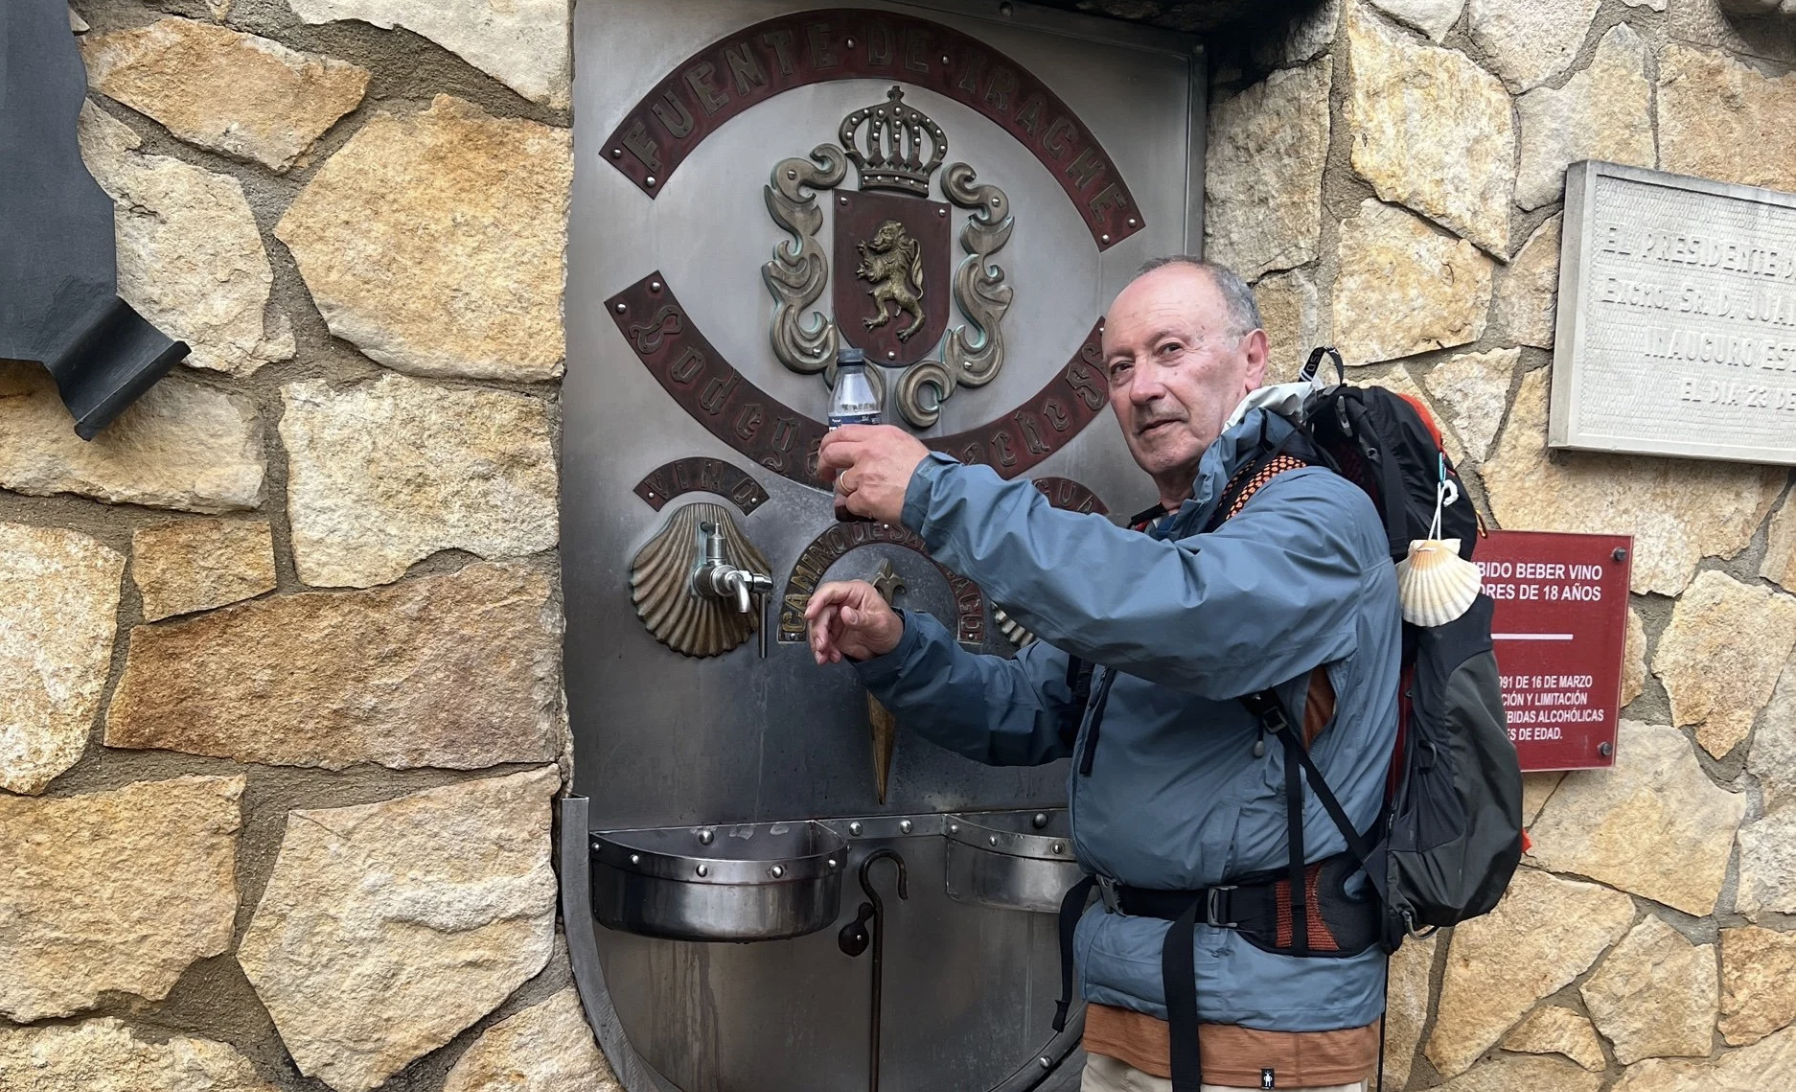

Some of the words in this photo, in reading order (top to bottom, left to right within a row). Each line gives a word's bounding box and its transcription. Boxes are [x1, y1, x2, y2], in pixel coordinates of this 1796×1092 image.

[621, 23, 839, 173] FUENTE
[867, 24, 934, 73] DE
[958, 51, 1127, 224] IRACHE
[1602, 222, 1631, 255] EL
[1641, 227, 1778, 277] PRESIDENTE
[629, 304, 823, 478] Bodega
[1681, 377, 1701, 403] EL
[643, 460, 759, 505] VINO
[1033, 479, 1094, 513] GUA
[781, 525, 848, 633] CAMINO
[850, 521, 885, 546] DE
[1474, 561, 1512, 578] BIDO
[1515, 562, 1566, 580] BEBER
[1568, 564, 1603, 581] VINO
[1519, 583, 1539, 600] DE
[1543, 584, 1559, 601] 18
[1561, 582, 1602, 602] AÑOS
[1515, 675, 1530, 689] DE
[1532, 675, 1542, 689] 16
[1543, 675, 1558, 689] DE
[1559, 674, 1593, 688] MARZO
[1501, 690, 1525, 707] CIÓN
[1526, 693, 1534, 707] Y
[1535, 689, 1588, 706] LIMITACIÓN
[1506, 709, 1537, 724] BIDAS
[1538, 706, 1604, 724] ALCOHÓLICAS
[1518, 727, 1533, 741] DE
[1534, 726, 1563, 741] EDAD.
